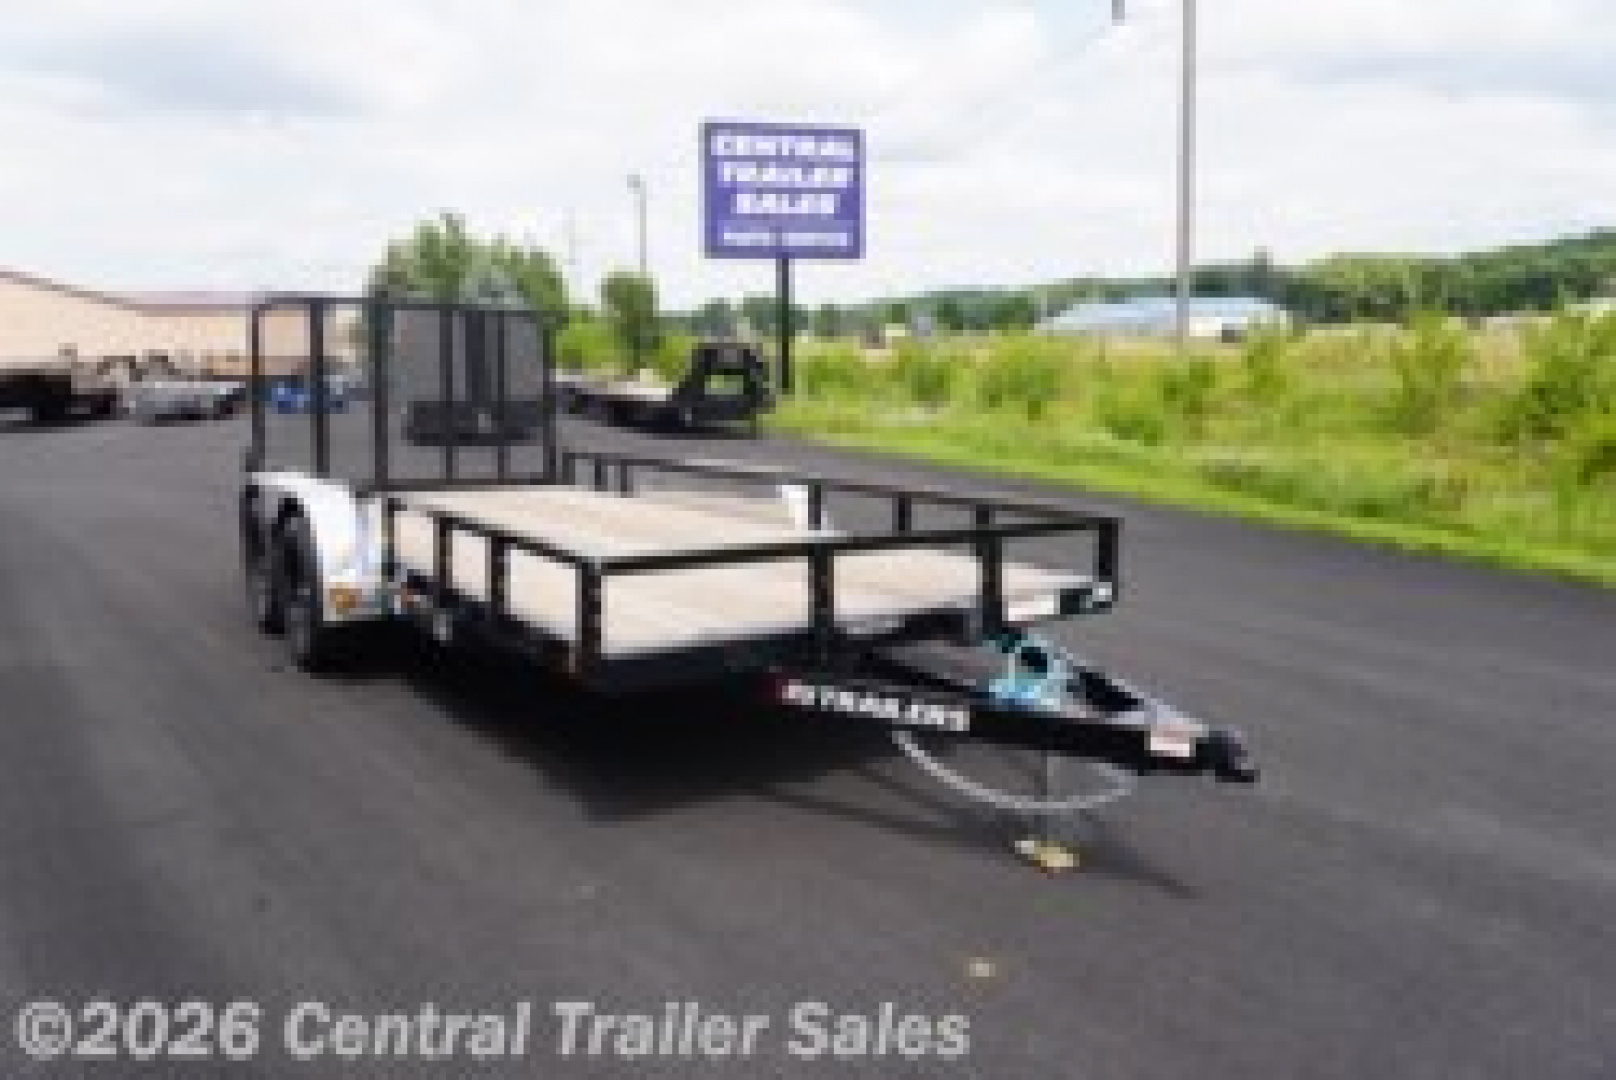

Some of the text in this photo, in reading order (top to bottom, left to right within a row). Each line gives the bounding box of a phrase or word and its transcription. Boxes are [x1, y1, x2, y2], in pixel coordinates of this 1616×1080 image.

[712, 133, 854, 160] CENTRAL
[719, 162, 853, 188] TRAILER
[735, 191, 837, 216] SALES
